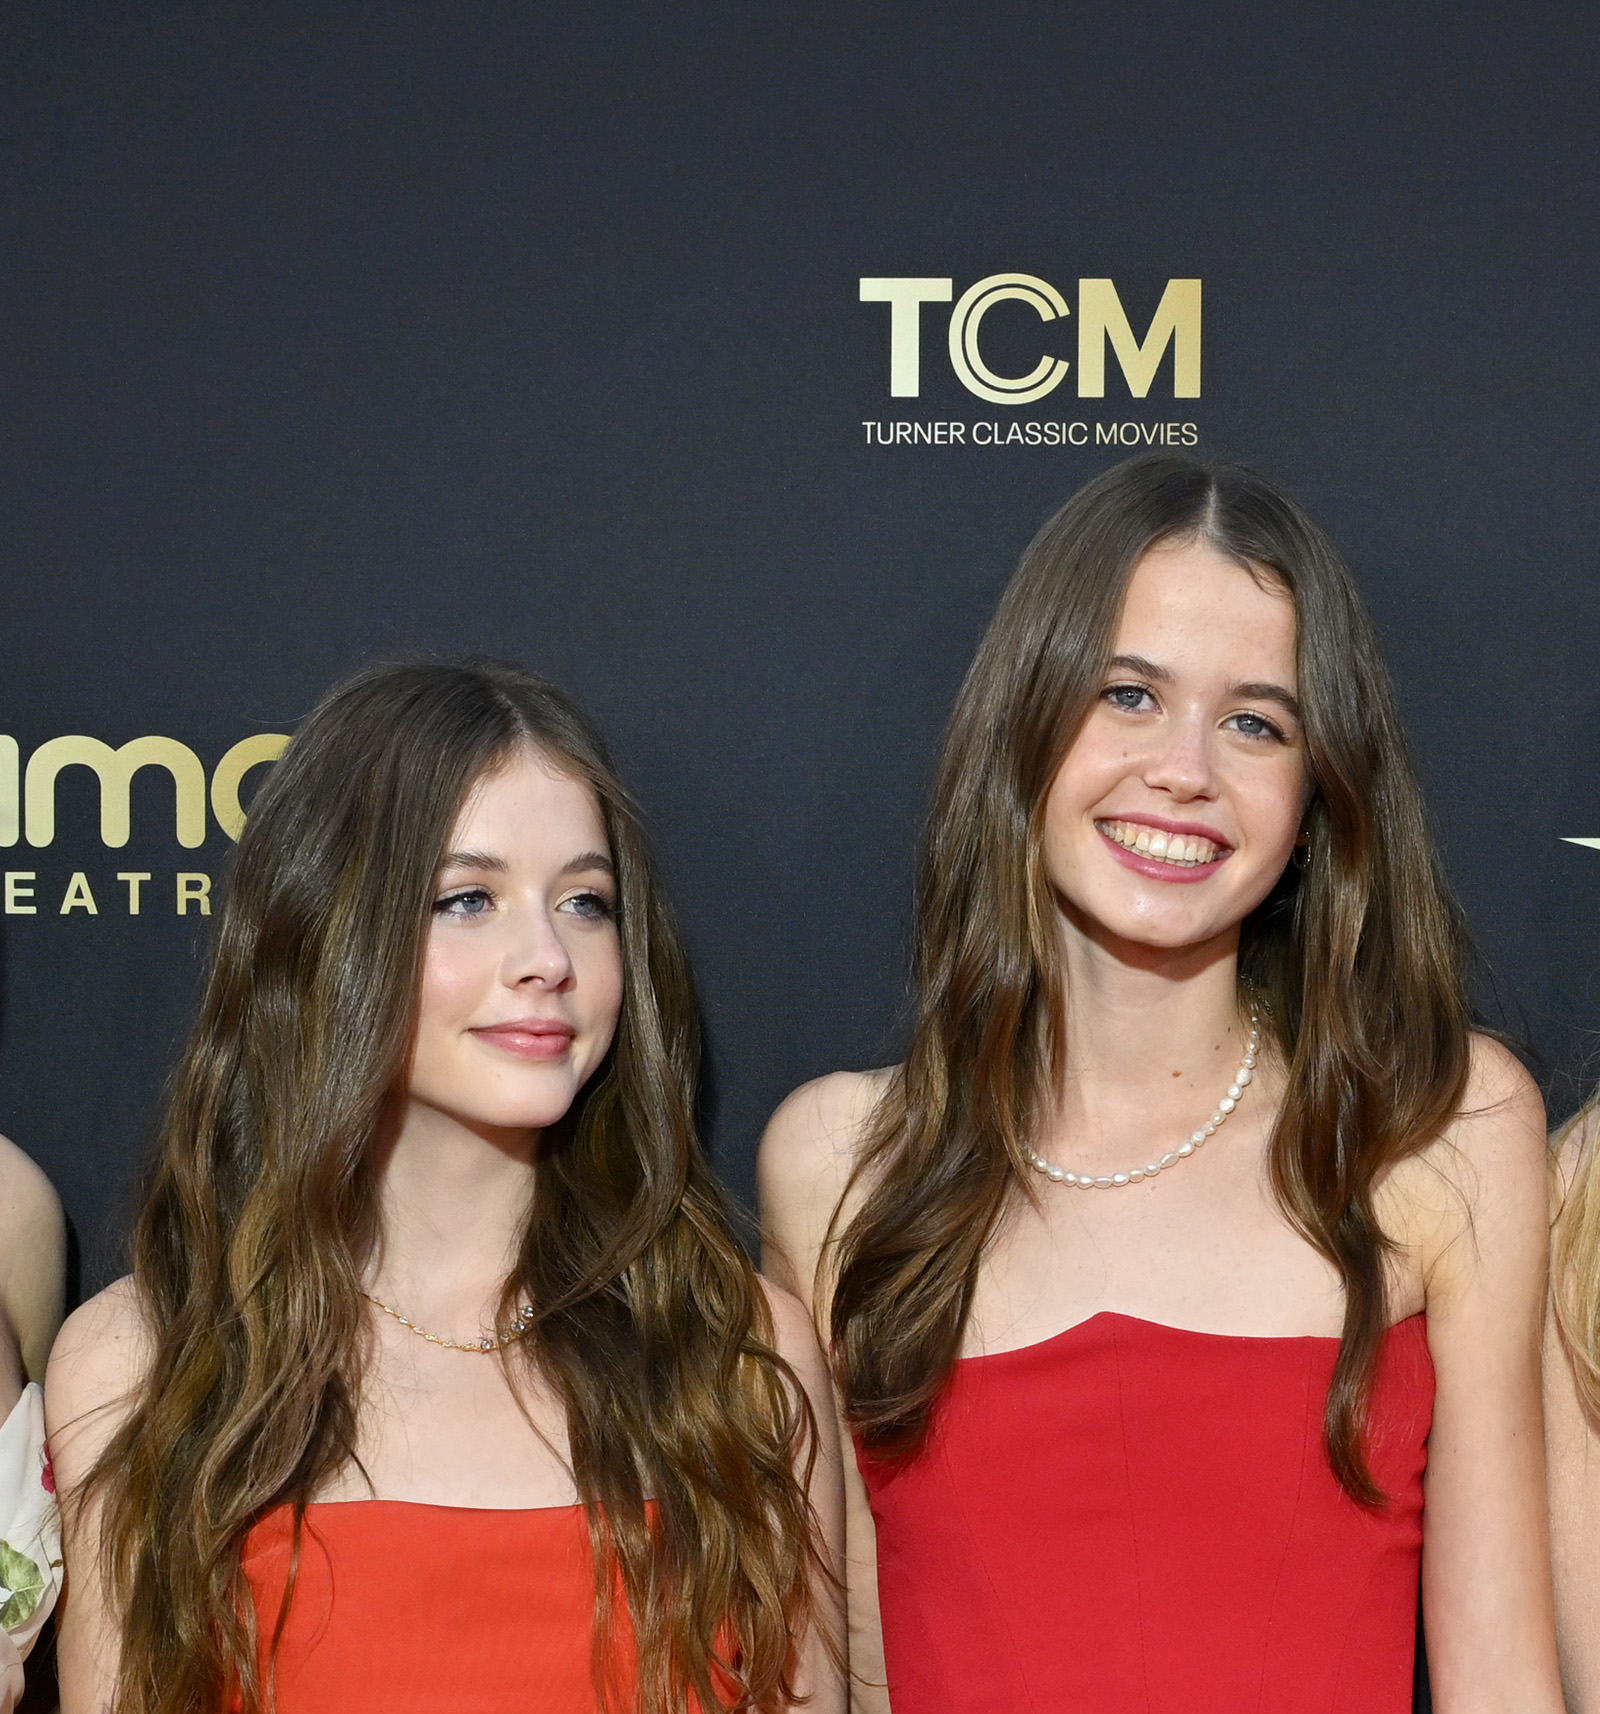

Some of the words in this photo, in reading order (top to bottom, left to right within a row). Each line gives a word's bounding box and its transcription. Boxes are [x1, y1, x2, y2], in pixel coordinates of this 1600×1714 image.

[859, 273, 1202, 406] TCM
[861, 421, 966, 446] TURNER
[972, 421, 1089, 446] CLASSIC
[1095, 422, 1199, 447] MOVIES
